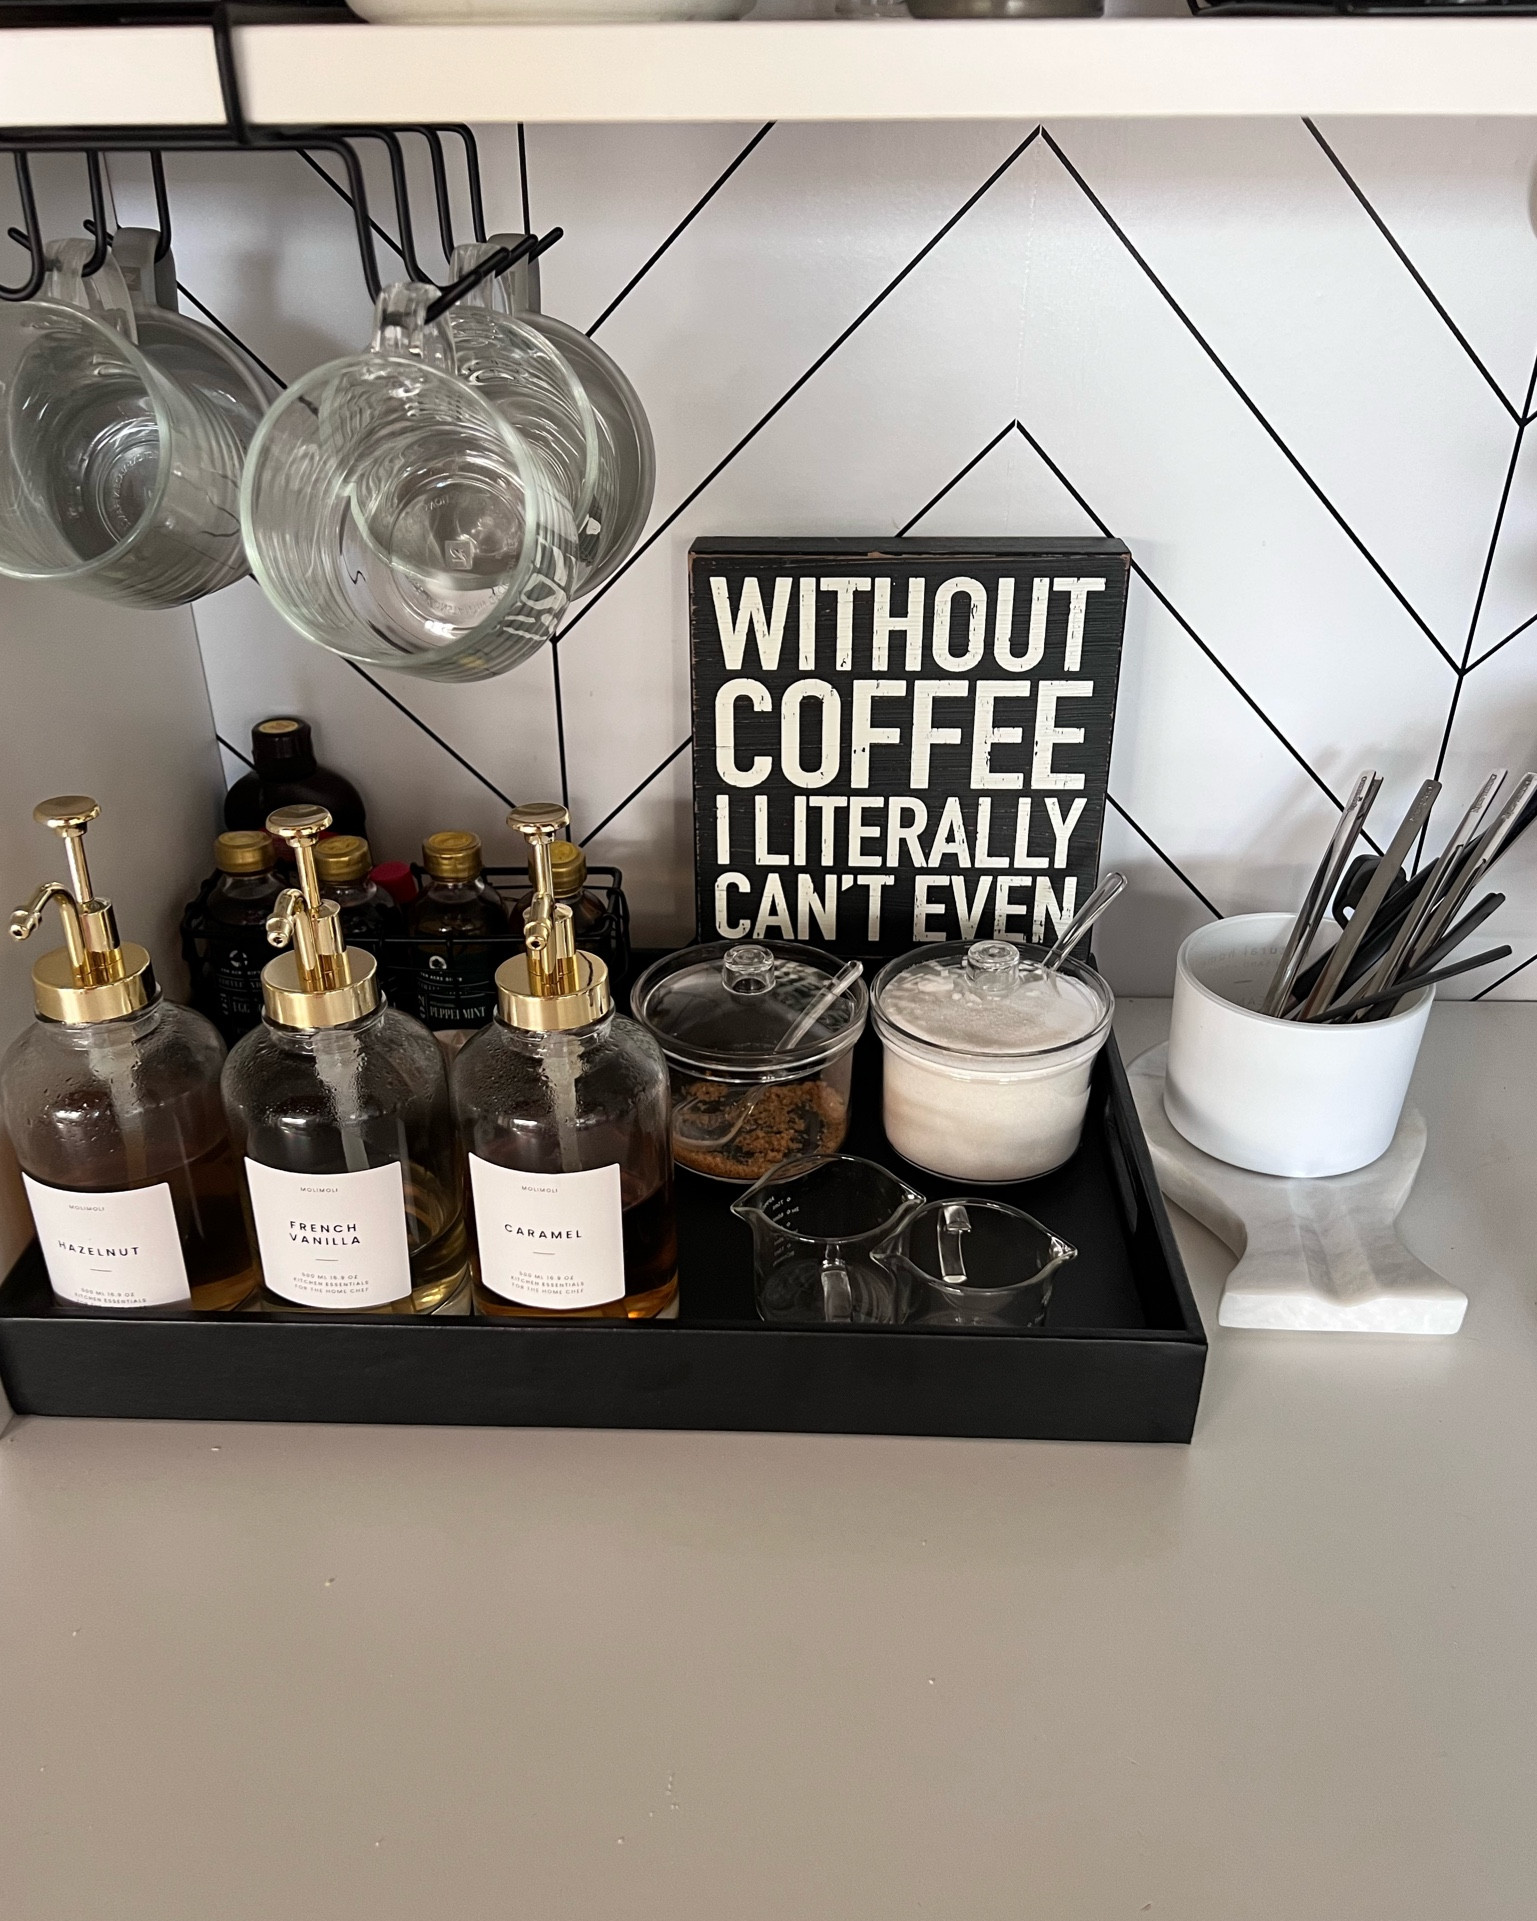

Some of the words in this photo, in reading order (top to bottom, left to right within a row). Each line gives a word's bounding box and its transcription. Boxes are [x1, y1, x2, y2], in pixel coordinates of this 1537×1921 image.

[709, 576, 1106, 672] WITHOUT
[715, 678, 1094, 790] COFFEE
[716, 795, 730, 865] I
[754, 795, 1088, 869] LITERALLY
[714, 872, 895, 942] CAN'T
[912, 874, 1078, 943] EVEN
[521, 1185, 558, 1193] MOLIMOLI
[290, 1220, 357, 1233] FRENCH
[504, 1223, 583, 1239] CARAMEL
[289, 1233, 361, 1246] VANILLA
[57, 1240, 140, 1257] HAZELNUT
[293, 1277, 323, 1286] KITCHEN
[510, 1275, 540, 1286] KITCHEN
[511, 1282, 524, 1290] FOR
